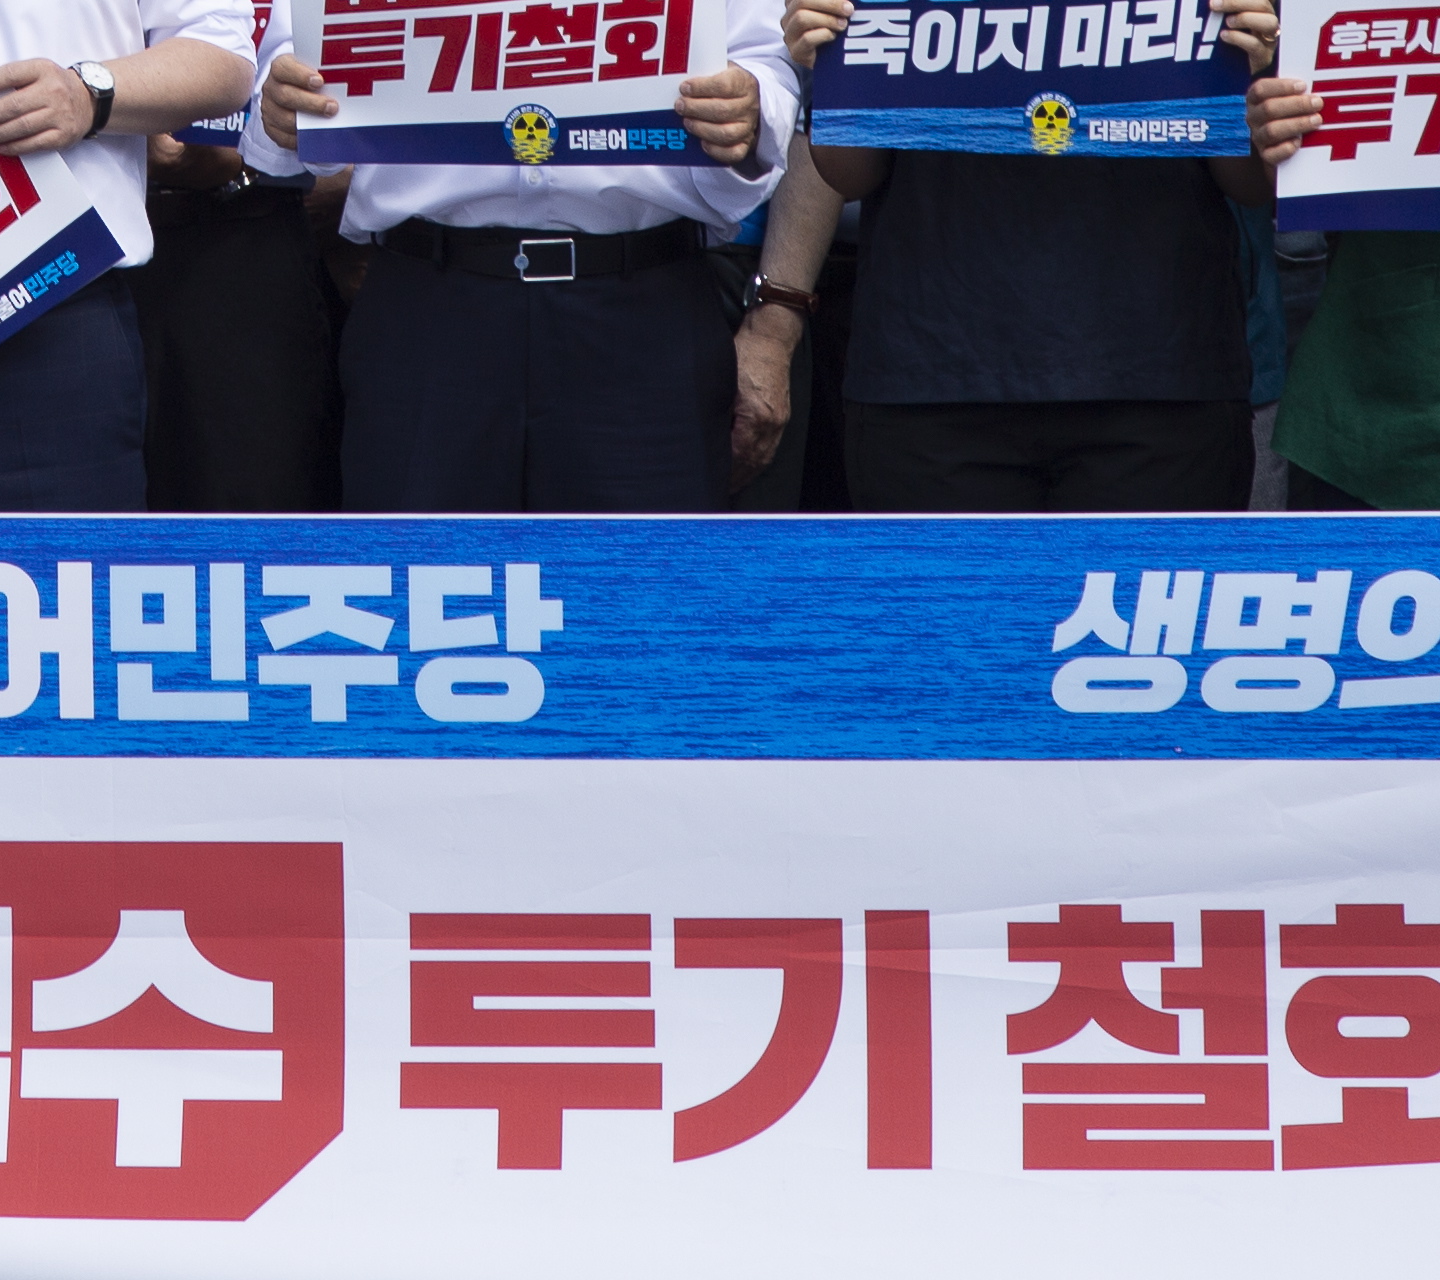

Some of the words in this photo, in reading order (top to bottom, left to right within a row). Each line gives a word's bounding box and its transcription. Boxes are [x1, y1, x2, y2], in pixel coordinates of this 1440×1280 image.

[844, 6, 1051, 74] 죽이지
[570, 127, 687, 150] 더불어민주당
[1089, 119, 1209, 142] 더불어민주당
[400, 910, 932, 1170] 투기
